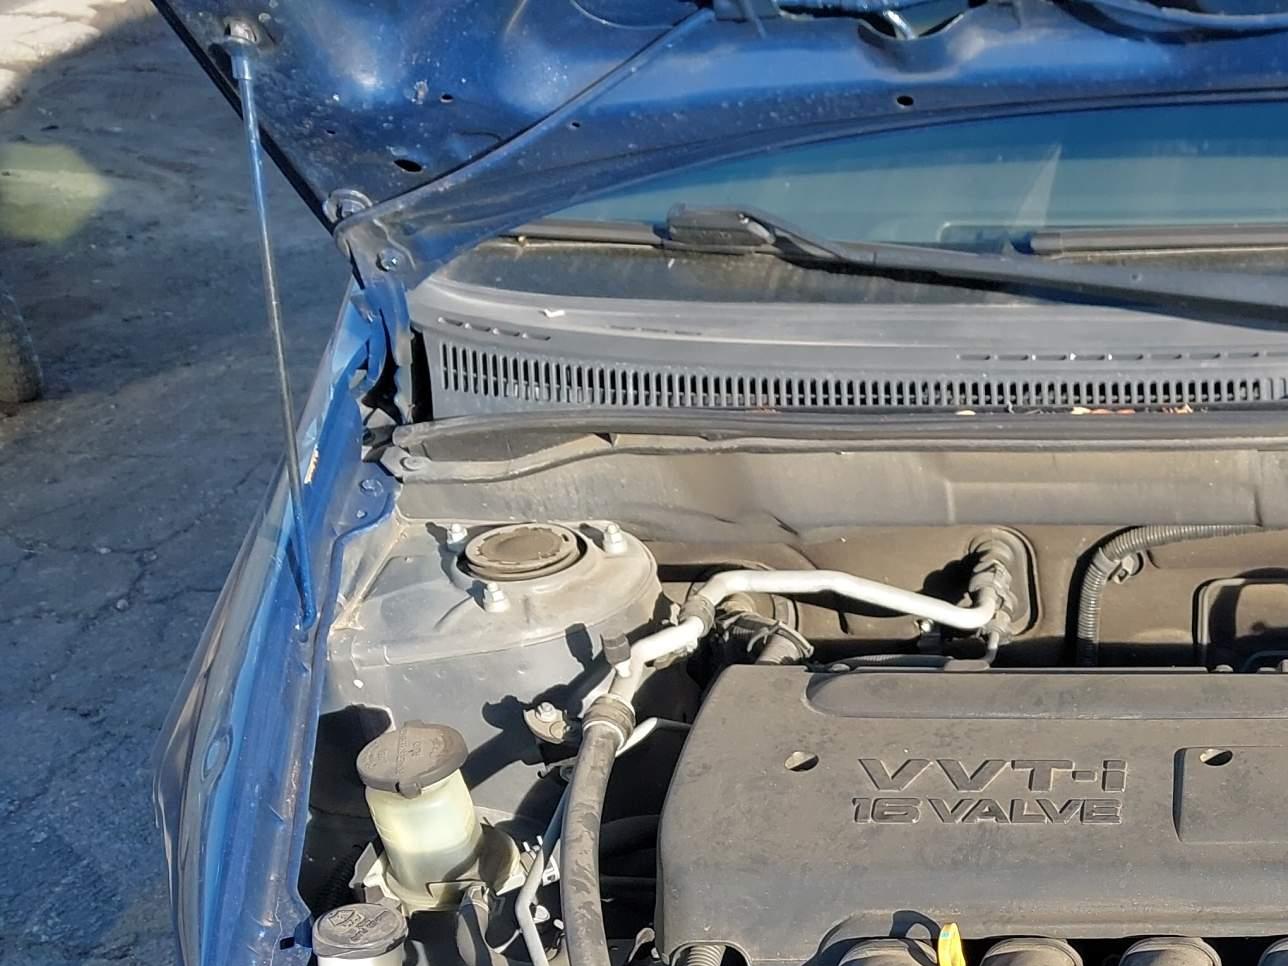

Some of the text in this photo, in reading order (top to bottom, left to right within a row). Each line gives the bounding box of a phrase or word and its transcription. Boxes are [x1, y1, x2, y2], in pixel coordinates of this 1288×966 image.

[857, 758, 1128, 793] VVT-i
[852, 797, 1123, 825] 16 VALVE
